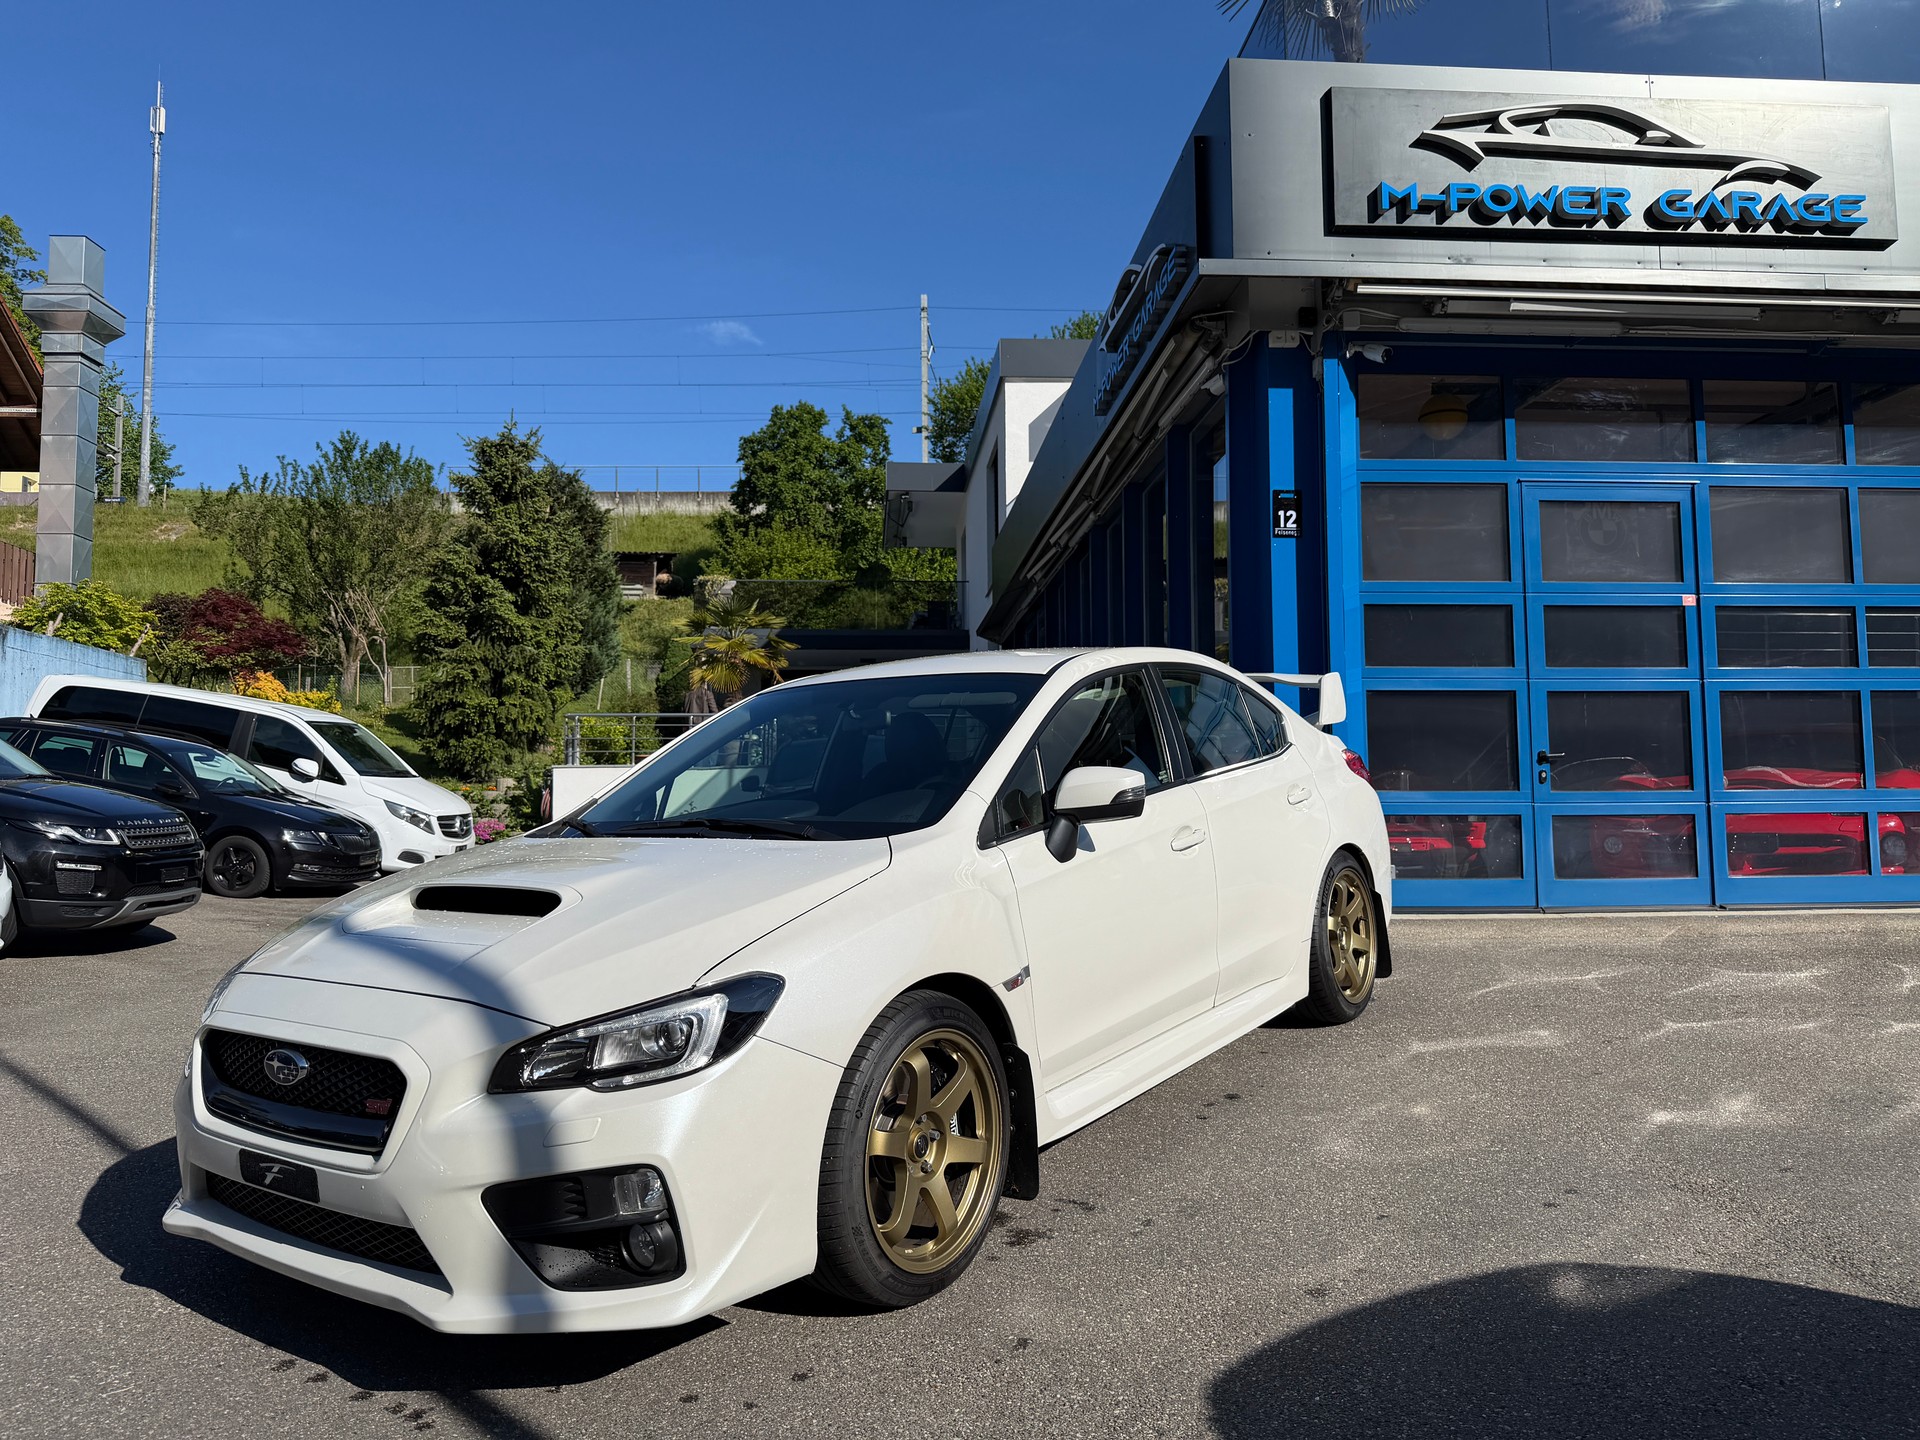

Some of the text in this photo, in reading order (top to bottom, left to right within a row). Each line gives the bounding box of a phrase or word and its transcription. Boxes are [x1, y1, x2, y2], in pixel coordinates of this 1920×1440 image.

[1379, 179, 1869, 224] M-POWER GARAGE
[1132, 246, 1177, 343] GARAGE
[1278, 510, 1297, 528] 12
